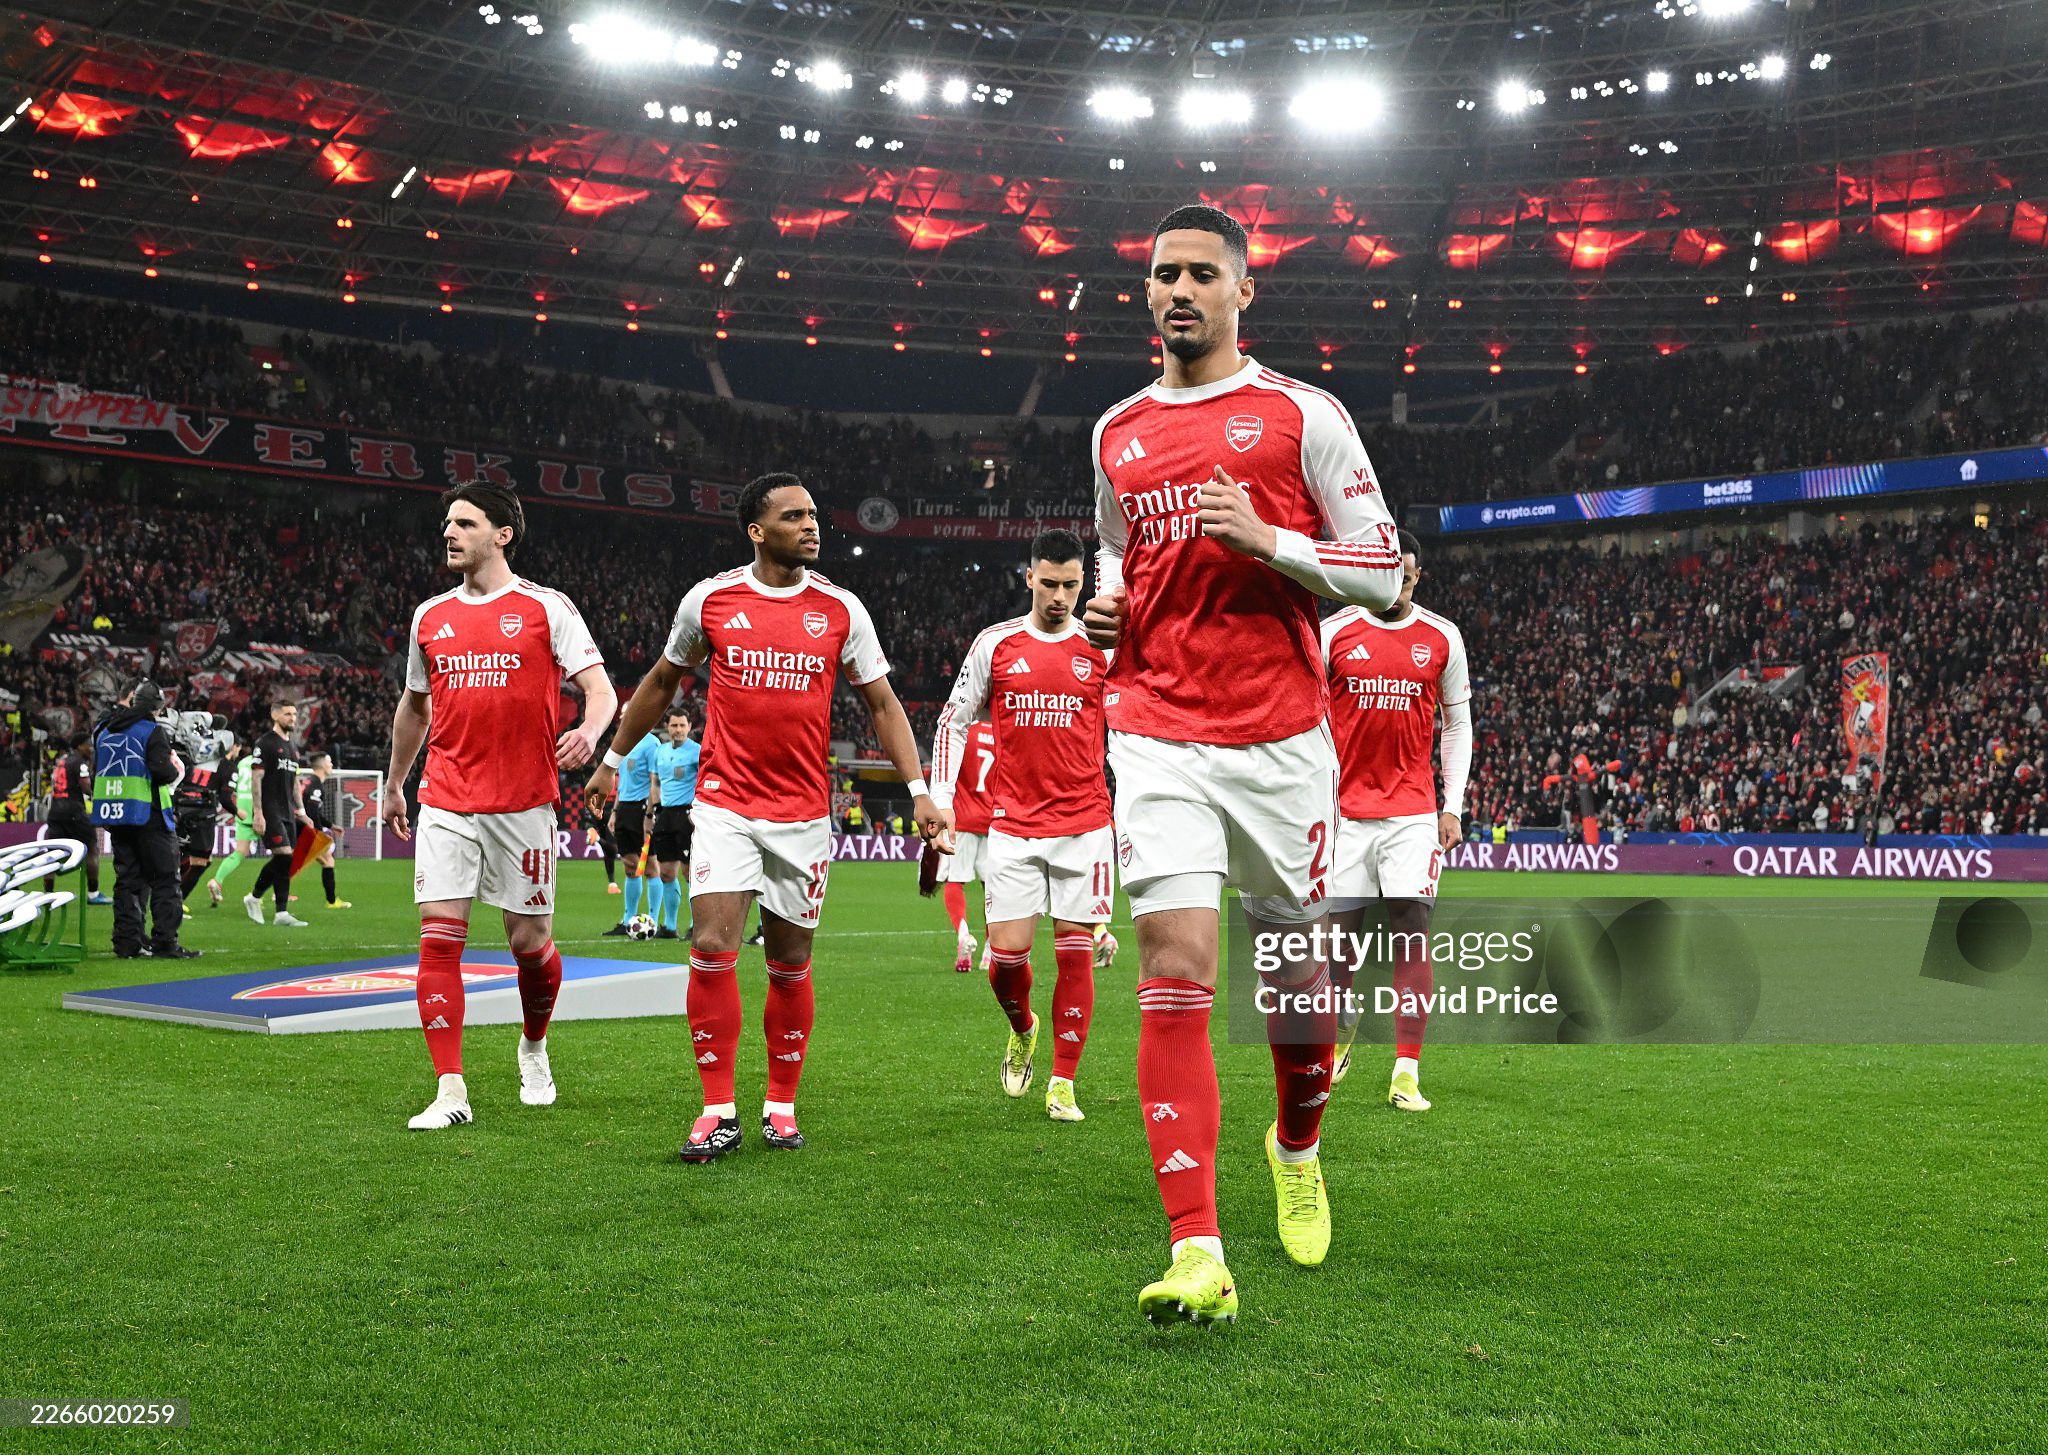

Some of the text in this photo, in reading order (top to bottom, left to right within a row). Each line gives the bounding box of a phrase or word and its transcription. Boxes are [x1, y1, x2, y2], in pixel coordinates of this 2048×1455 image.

[1231, 420, 1258, 428] Arsenal
[1118, 477, 1250, 523] Emiras
[1703, 480, 1752, 498] bet365
[978, 500, 1010, 518] und
[1495, 503, 1556, 521] crypto.com
[932, 522, 983, 538] vorm.
[1142, 518, 1165, 546] FLY
[435, 650, 521, 674] Emirates
[726, 645, 826, 674] Emirates
[448, 671, 508, 690] FLY BETTER
[741, 669, 811, 692] FLY BETTER
[1346, 674, 1423, 697] Emirates
[1004, 689, 1084, 712] Emirates
[1358, 694, 1411, 711] FLY BETTER
[1014, 711, 1073, 728] FLY BETTER
[976, 748, 995, 792] 7
[105, 780, 123, 796] HB
[1307, 819, 1328, 881] 2
[1442, 842, 1619, 870] TAR AIRWAYS
[522, 848, 549, 885] 41
[1428, 849, 1443, 881] 6
[1733, 846, 1993, 878] QATAR AIRWAYS
[808, 860, 829, 900] 12
[1092, 861, 1110, 897] 11
